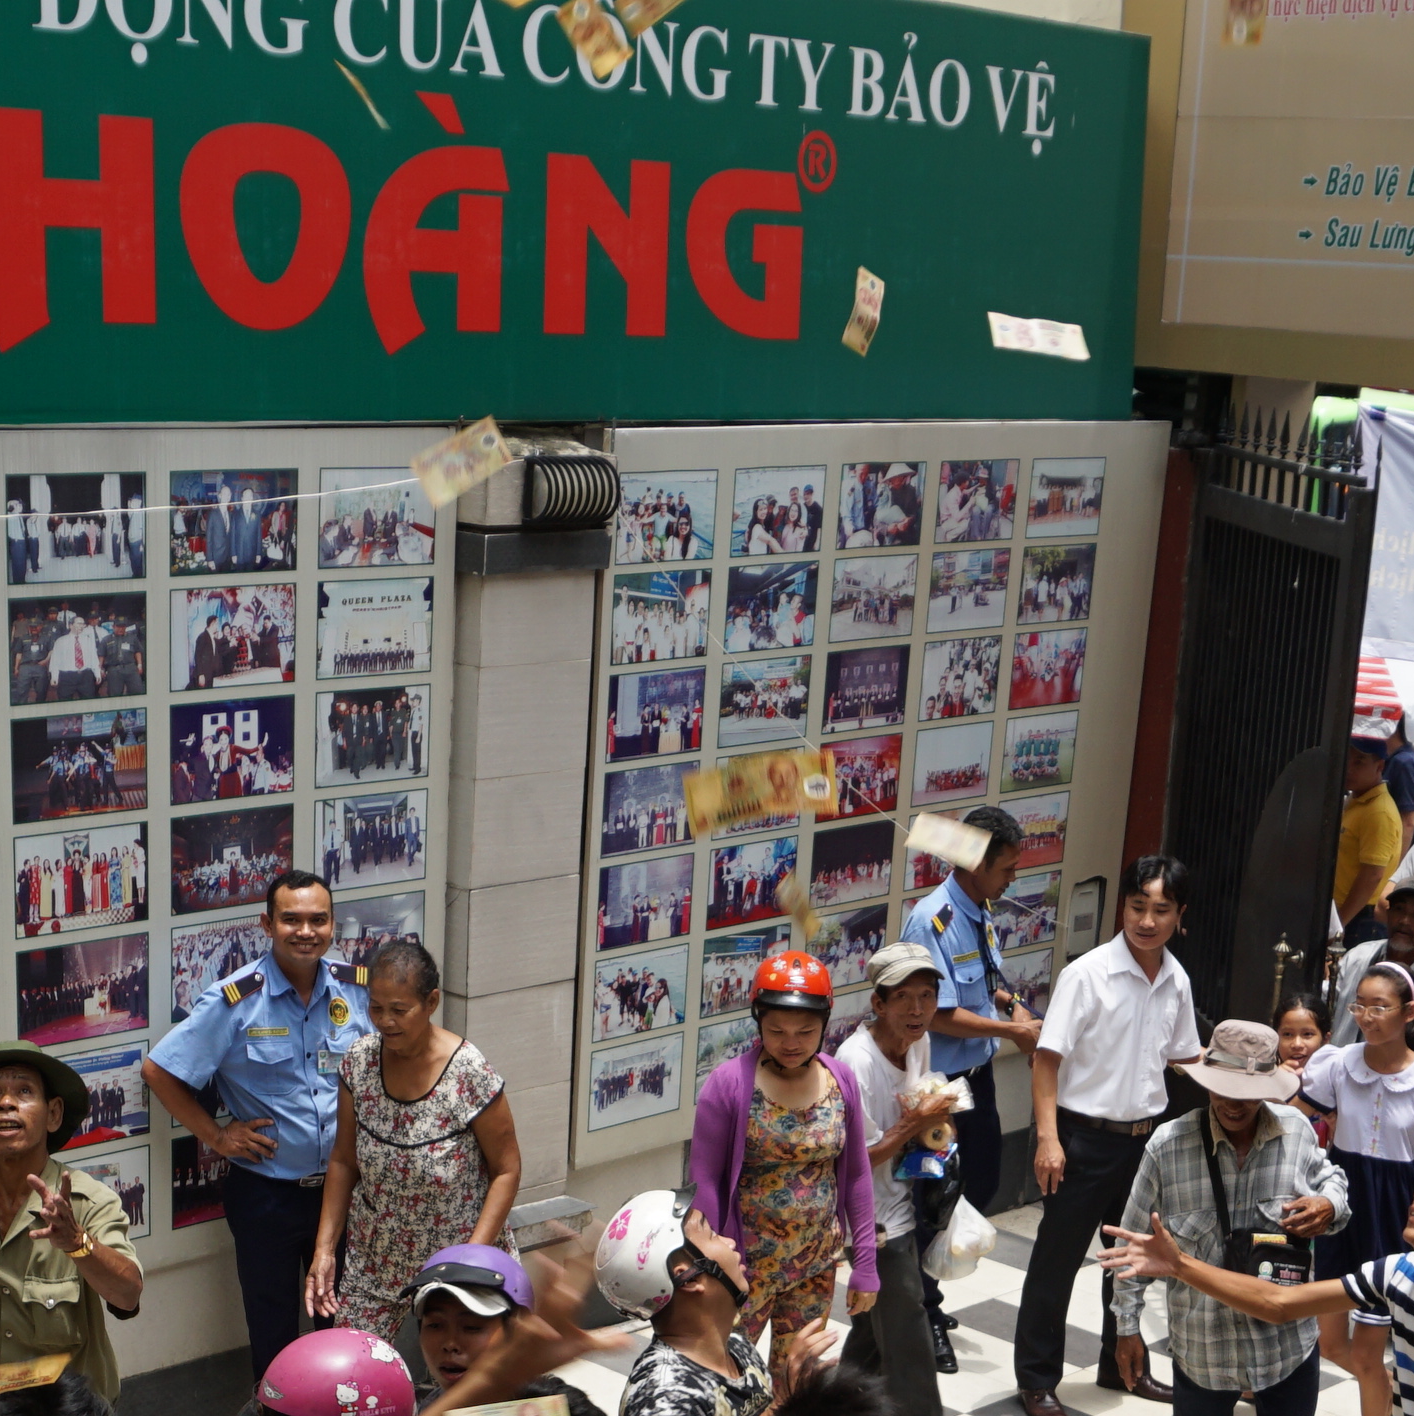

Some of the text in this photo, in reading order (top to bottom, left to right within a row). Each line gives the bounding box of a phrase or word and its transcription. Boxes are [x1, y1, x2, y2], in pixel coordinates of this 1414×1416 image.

[748, 33, 835, 112] TY
[846, 32, 970, 126] BẢO
[986, 61, 1055, 155] VỆ
[1324, 162, 1365, 197] Bảo
[1374, 165, 1400, 203] Vệ
[1323, 217, 1363, 248] Sau
[341, 594, 413, 606] QUEEN PLAZA
